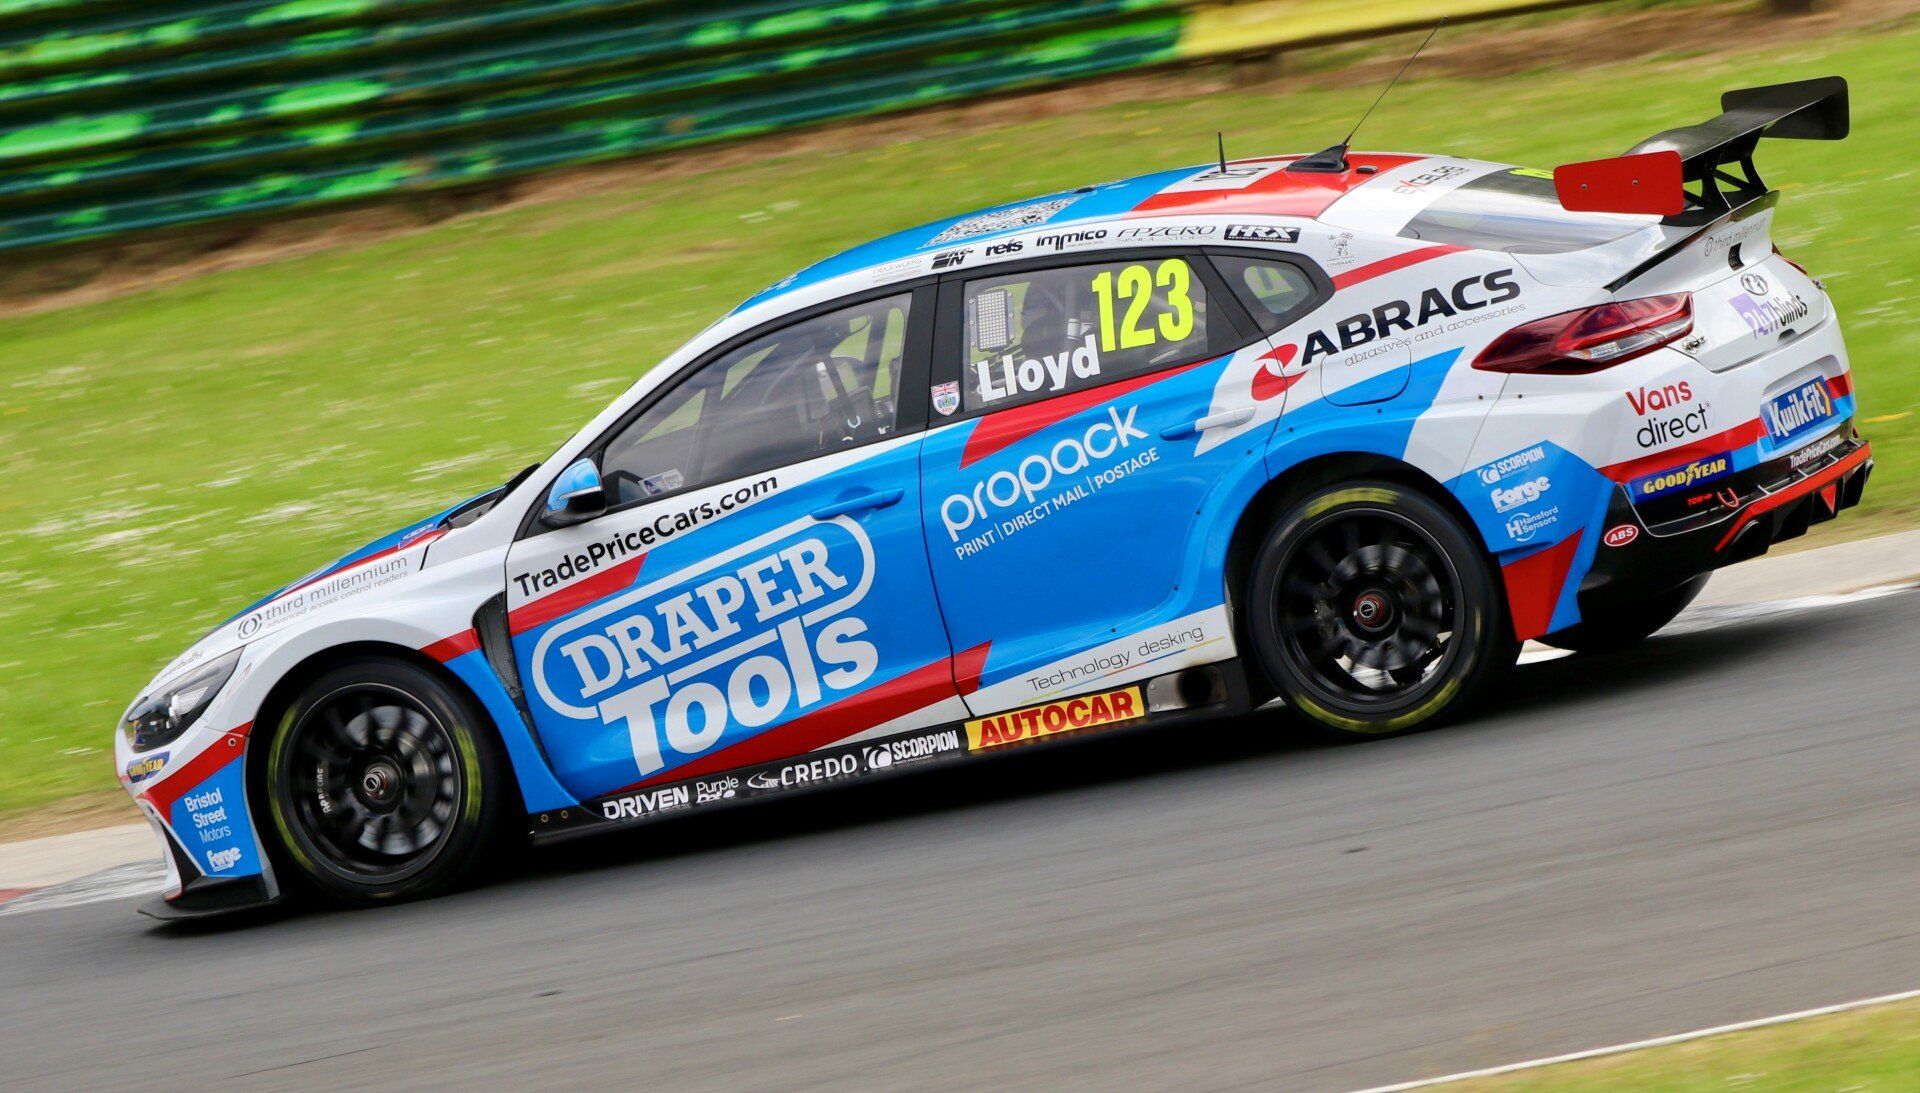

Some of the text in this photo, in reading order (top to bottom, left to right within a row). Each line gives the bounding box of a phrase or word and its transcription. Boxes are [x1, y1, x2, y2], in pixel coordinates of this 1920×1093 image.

[985, 240, 1024, 257] reis
[1036, 229, 1107, 251] immico
[1227, 224, 1300, 239] HRX
[1713, 232, 1733, 251] third
[1091, 257, 1195, 353] 123
[1301, 268, 1522, 367] ABRACS
[1344, 303, 1527, 368] abrasives and accessories
[977, 333, 1102, 403] Lloyd
[1625, 380, 1693, 416] Vans
[1636, 402, 1709, 448] direct
[940, 404, 1150, 543] propack
[1497, 446, 1546, 475] SCORPION
[1643, 458, 1727, 494] GOODYEAR
[955, 447, 1161, 561] PRINT DIRECT MAIL POSTAGE
[1519, 506, 1559, 526] Hansford
[513, 474, 778, 598] TradePriceCars.com
[1521, 515, 1557, 534] Sensors
[1610, 527, 1635, 543] ABS
[264, 556, 408, 621] third millennium
[266, 570, 408, 630] advanced access control readers
[561, 538, 848, 700] DRAPER
[1026, 625, 1205, 694] Technology desking
[598, 614, 879, 778] Tools
[979, 690, 1136, 749] AUTOCAR
[891, 730, 960, 761] SCORPION
[696, 776, 739, 796] Purple
[780, 753, 858, 786] CREDO
[184, 787, 224, 813] Bristol
[192, 806, 228, 829] Street
[602, 785, 689, 820] DRIVEN
[198, 825, 232, 844] Motors
